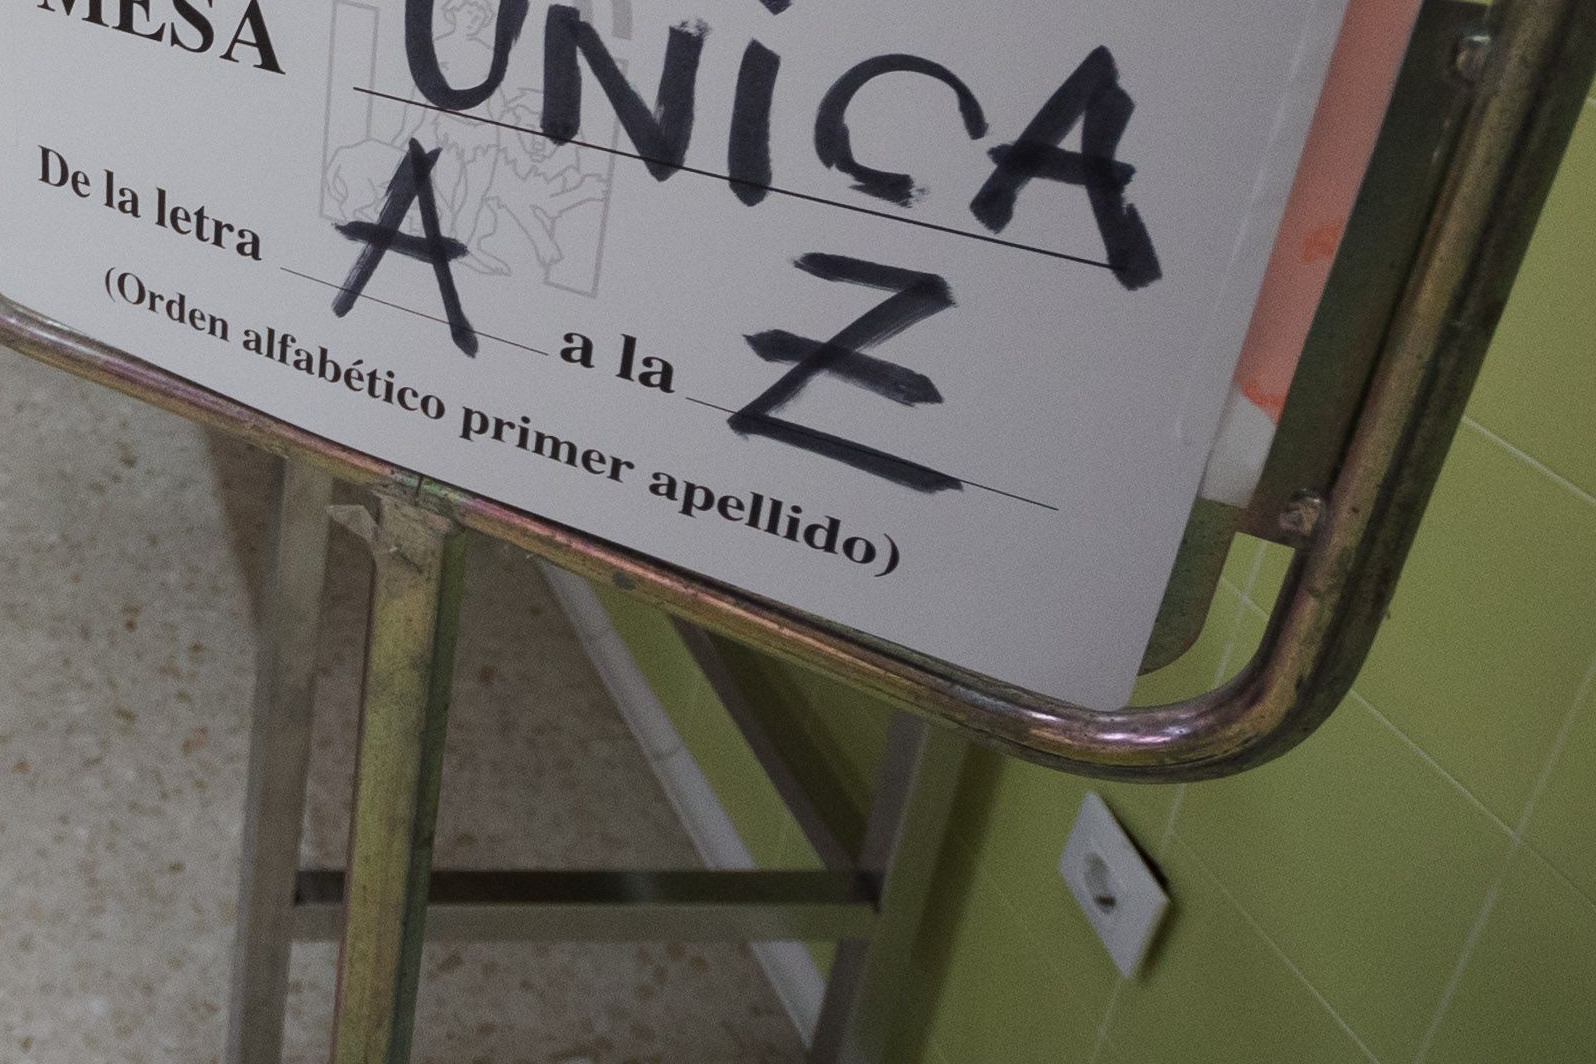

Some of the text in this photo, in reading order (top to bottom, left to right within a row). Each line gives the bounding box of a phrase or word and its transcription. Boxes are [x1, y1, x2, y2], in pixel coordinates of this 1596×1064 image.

[38, 137, 966, 495] De la letra A a la Z
[103, 267, 902, 579] (Orden alfabético primer apellido)
